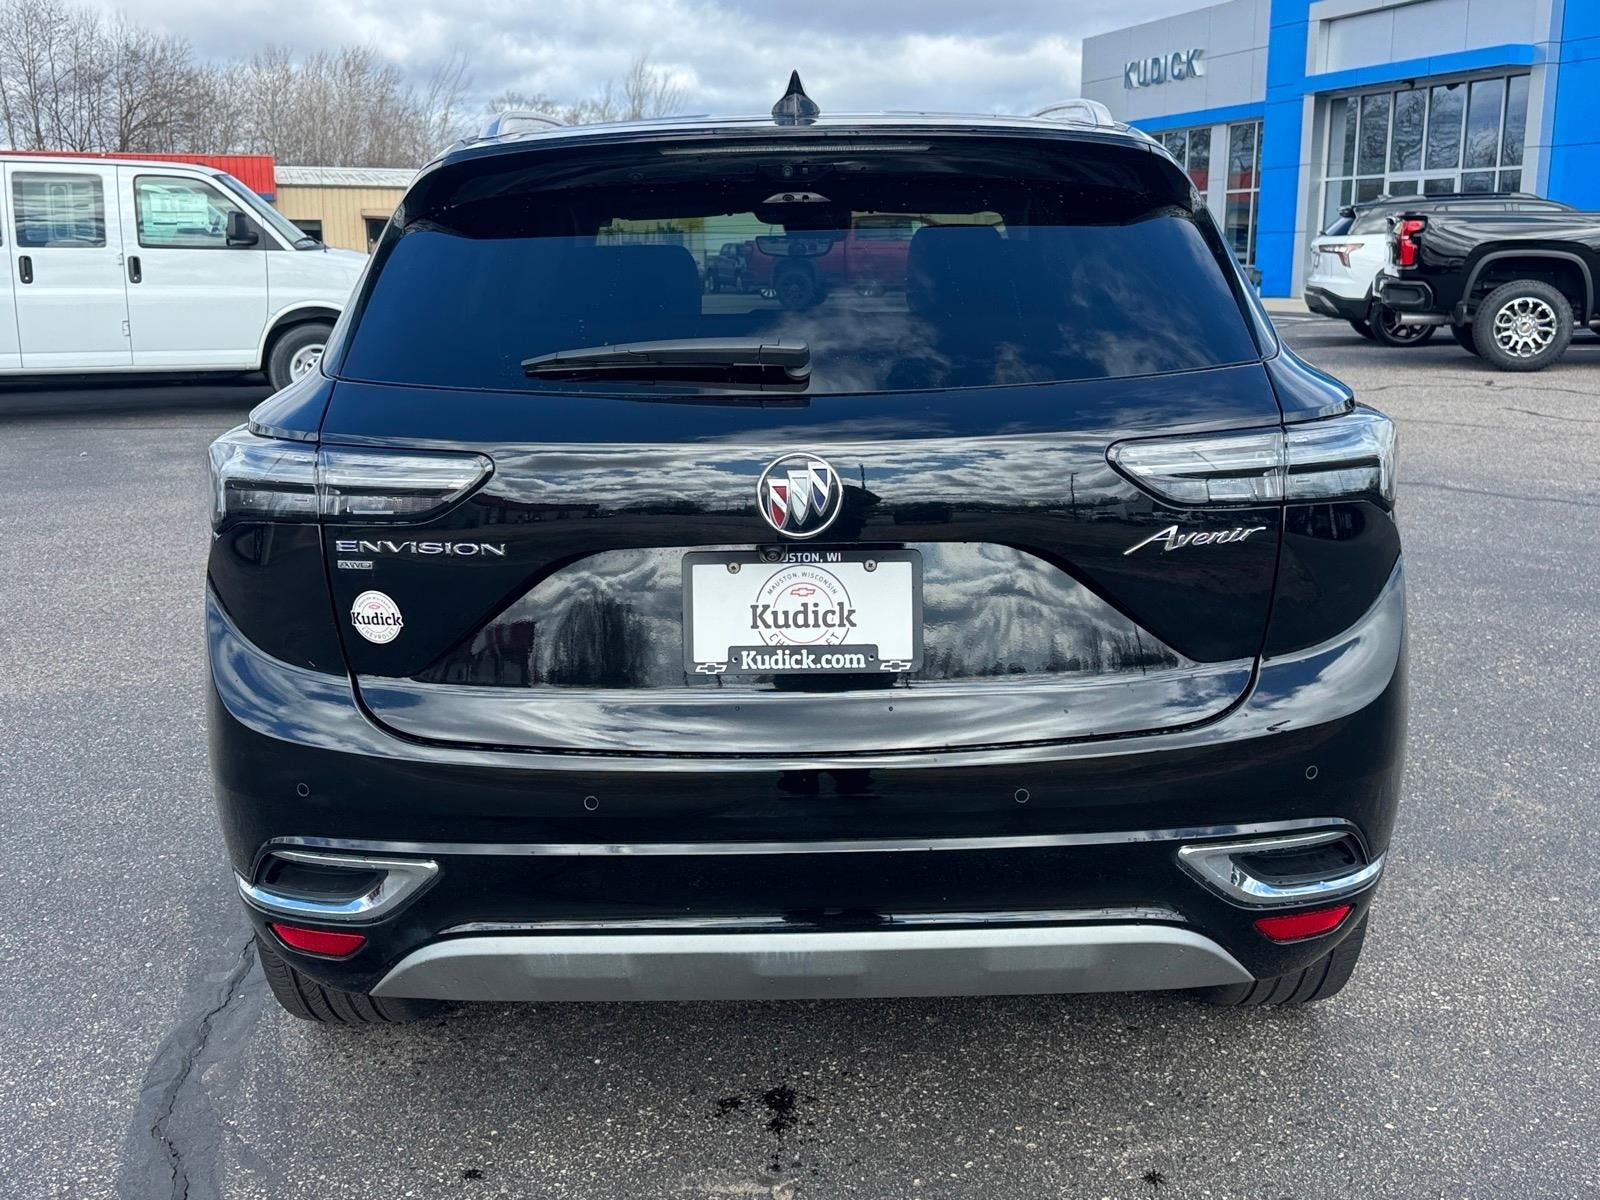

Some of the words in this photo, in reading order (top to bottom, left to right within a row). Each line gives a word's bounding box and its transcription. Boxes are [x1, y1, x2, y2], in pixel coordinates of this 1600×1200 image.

[1124, 49, 1204, 89] KUDICK
[336, 540, 506, 556] ENVISION
[1123, 525, 1266, 555] Avenir
[338, 561, 372, 569] AWD
[782, 552, 823, 563] USTON,
[826, 552, 842, 562] WI
[767, 572, 800, 595] MAUSTON,
[801, 571, 838, 594] WISCONSIN
[352, 612, 402, 626] Kudick
[750, 602, 857, 629] Kudick
[741, 650, 866, 670] Kudick.com
